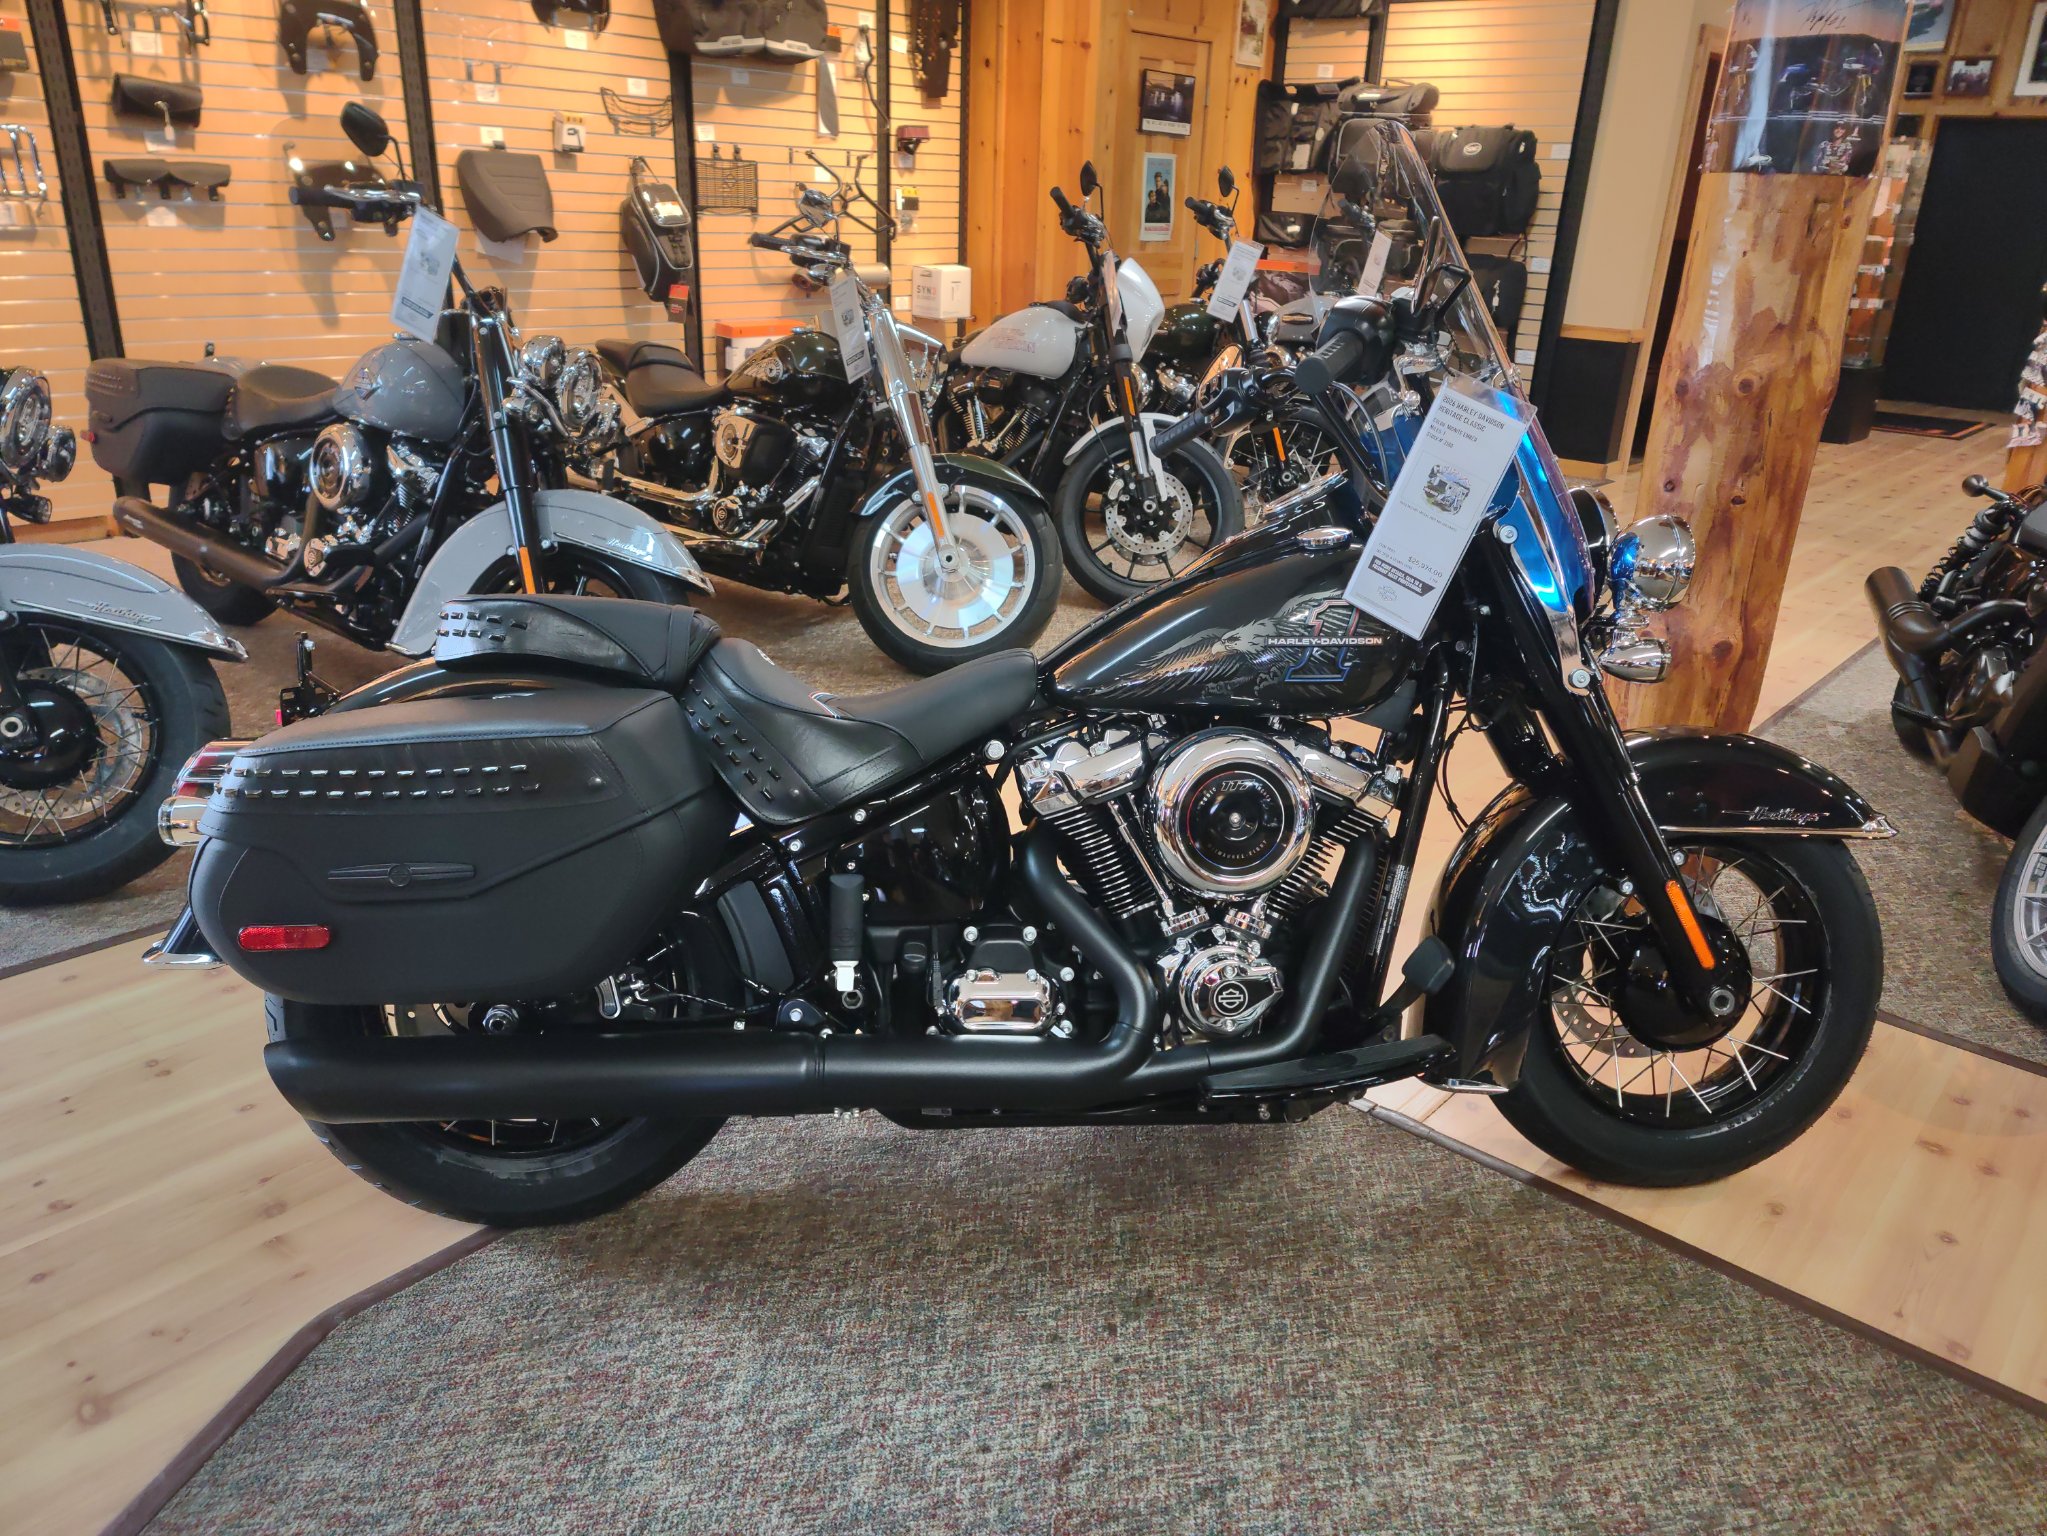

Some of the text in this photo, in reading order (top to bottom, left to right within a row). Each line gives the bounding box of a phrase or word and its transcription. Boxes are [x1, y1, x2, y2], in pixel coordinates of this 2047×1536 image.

[1442, 396, 1456, 407] 2026
[1439, 405, 1486, 432] HERITAGE CLASSIC
[1267, 637, 1383, 646] HARLEY-DAVIDSON
[1221, 779, 1255, 792] 117
